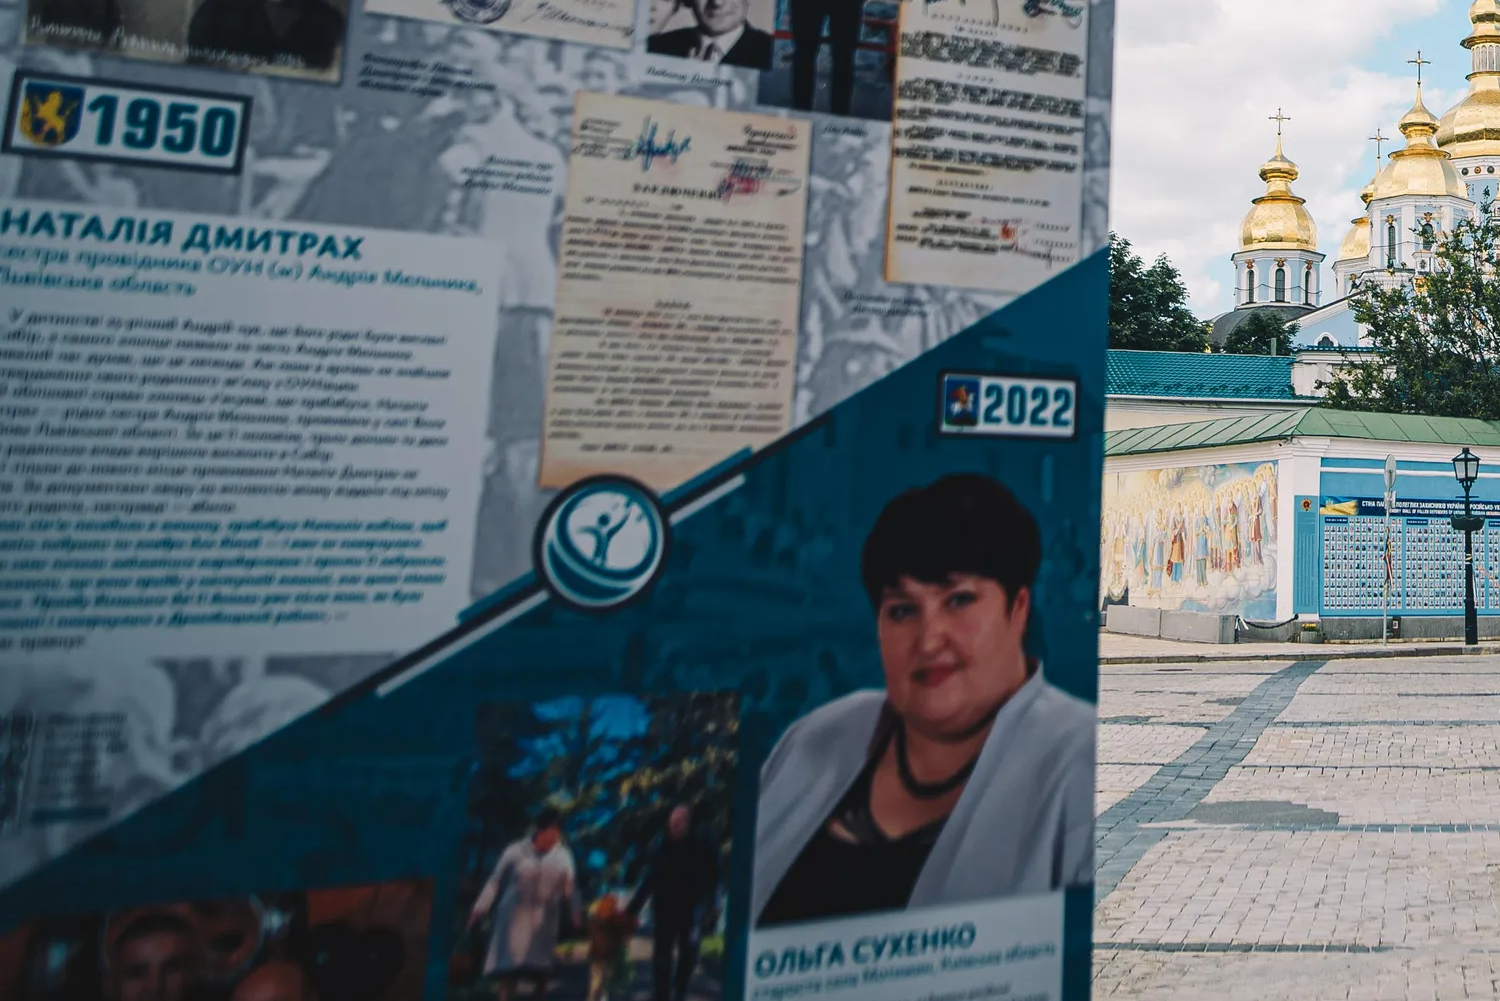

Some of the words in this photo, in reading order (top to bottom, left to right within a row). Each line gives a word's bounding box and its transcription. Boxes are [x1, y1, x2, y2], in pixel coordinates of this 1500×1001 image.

[88, 92, 238, 158] 1950
[0, 206, 174, 247] НАТАЛІЯ
[180, 221, 365, 261] ДМИТРАХ
[982, 382, 1074, 427] 2022
[754, 939, 846, 980] ОЛЬГА
[850, 920, 978, 965] СУХЕНКО
